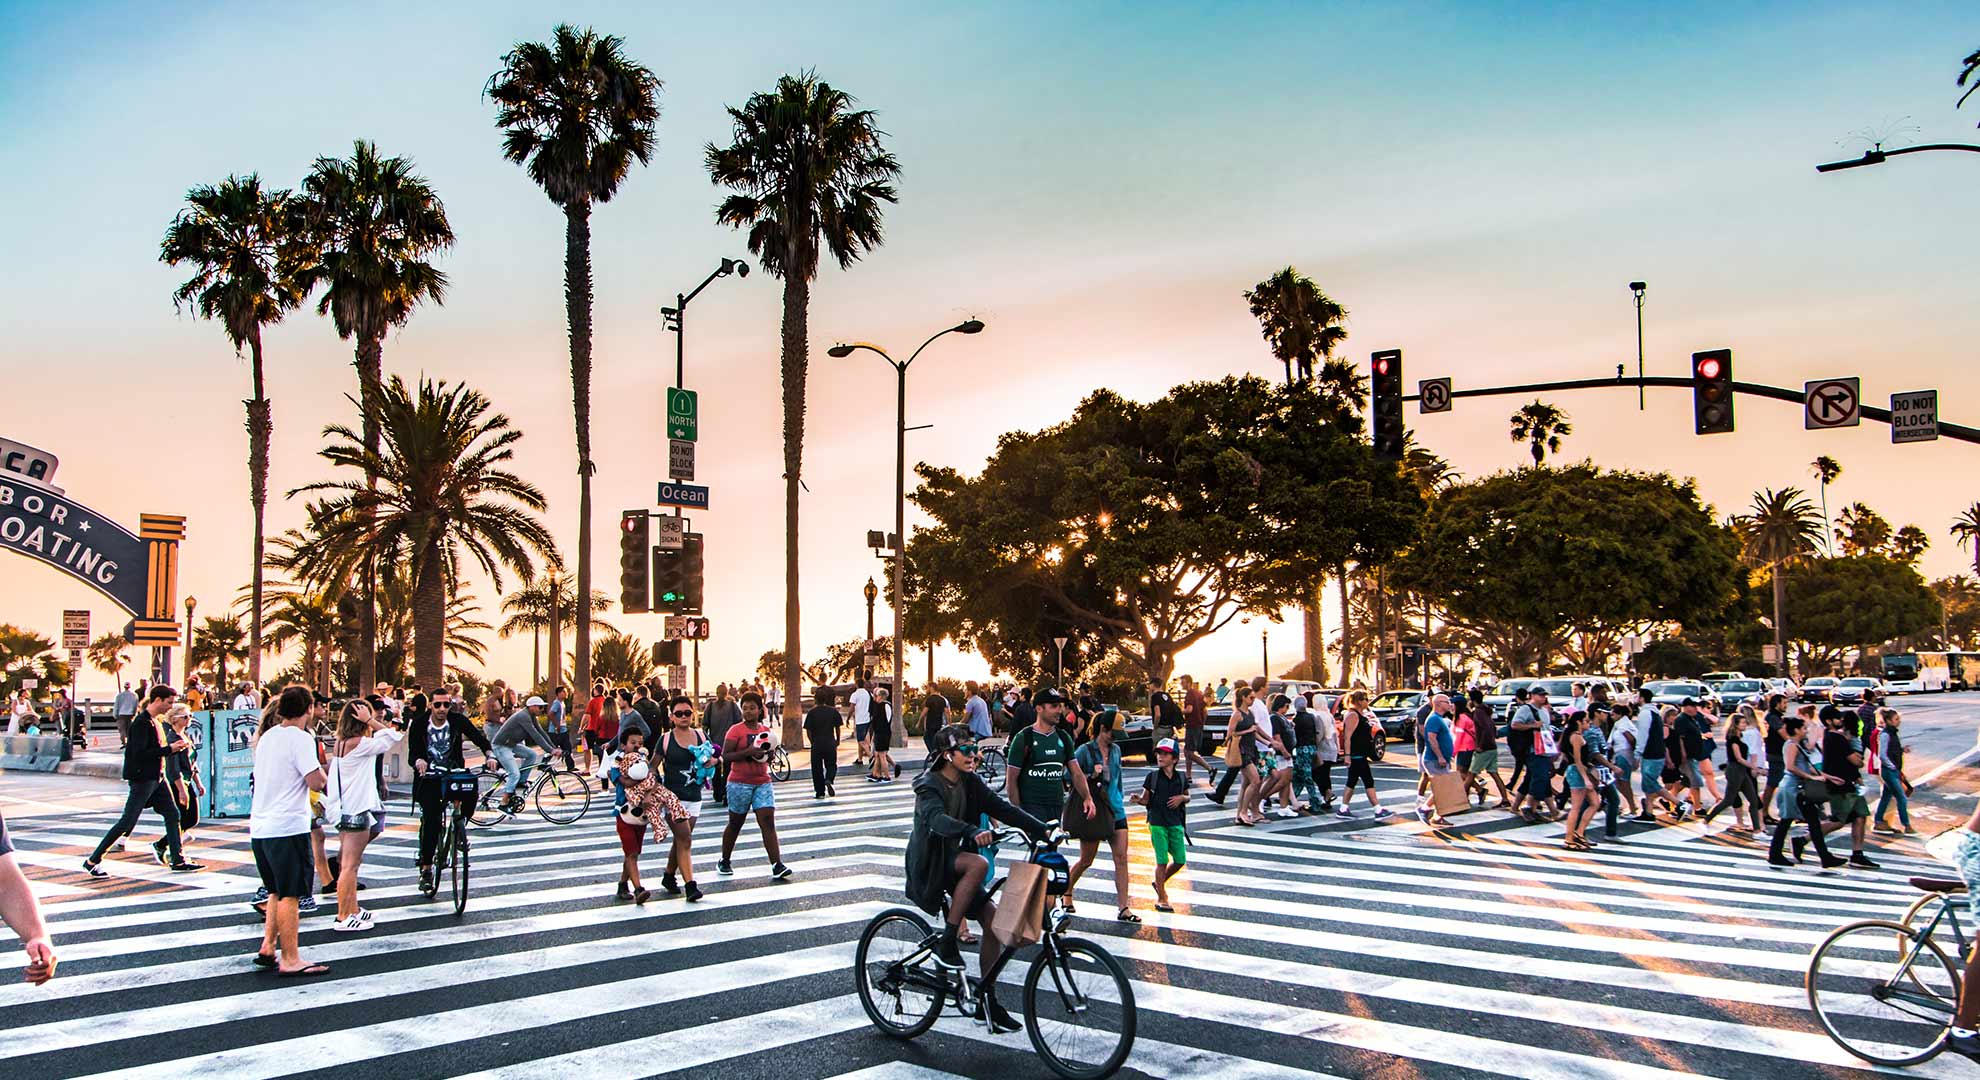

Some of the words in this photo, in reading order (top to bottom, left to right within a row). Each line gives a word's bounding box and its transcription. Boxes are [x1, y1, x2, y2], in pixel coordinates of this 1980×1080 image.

[1894, 399, 1909, 411] DO
[1912, 397, 1934, 409] NOT
[669, 415, 696, 427] NORTH
[1894, 413, 1935, 428] BLOCK
[0, 447, 48, 480] CA
[661, 485, 705, 502] Ocean
[1, 516, 118, 584] OATING
